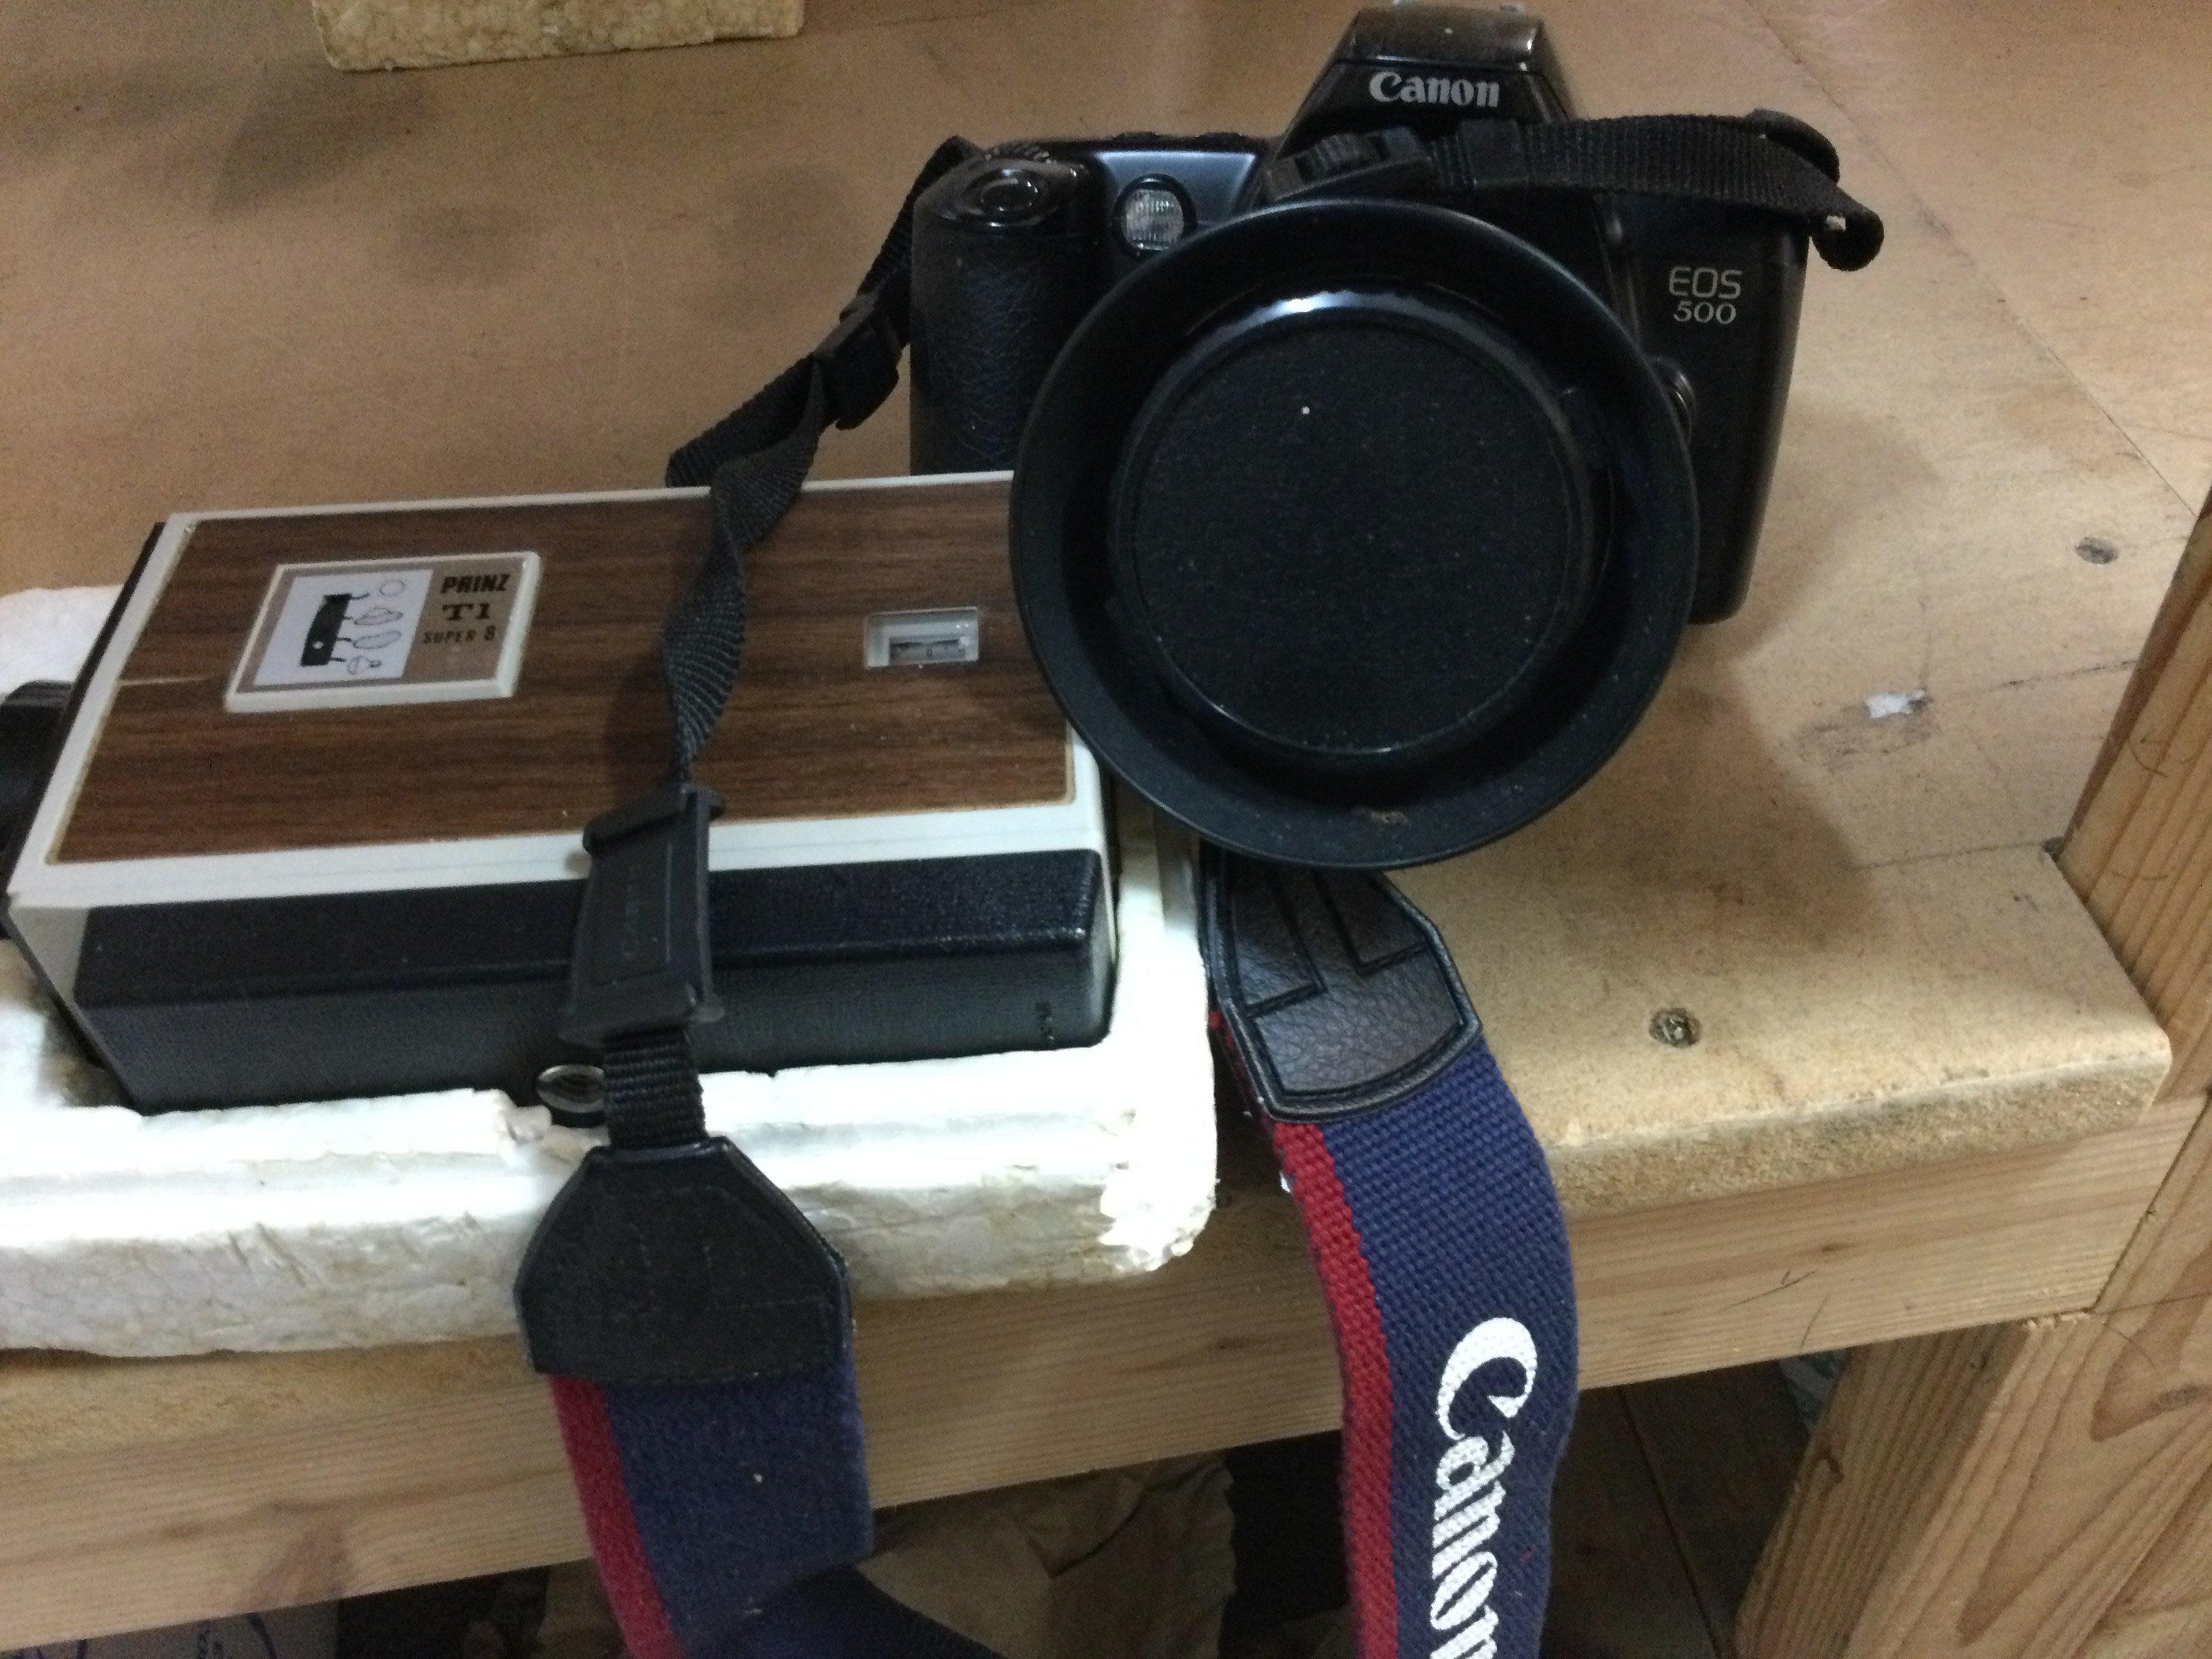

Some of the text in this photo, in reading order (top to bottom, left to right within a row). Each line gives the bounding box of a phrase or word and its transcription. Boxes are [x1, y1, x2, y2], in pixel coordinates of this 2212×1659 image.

[1368, 71, 1499, 108] Canon
[1668, 266, 1742, 299] EOS
[1673, 301, 1736, 325] 500
[441, 574, 510, 594] PRINZ
[423, 625, 497, 644] SUPER 8
